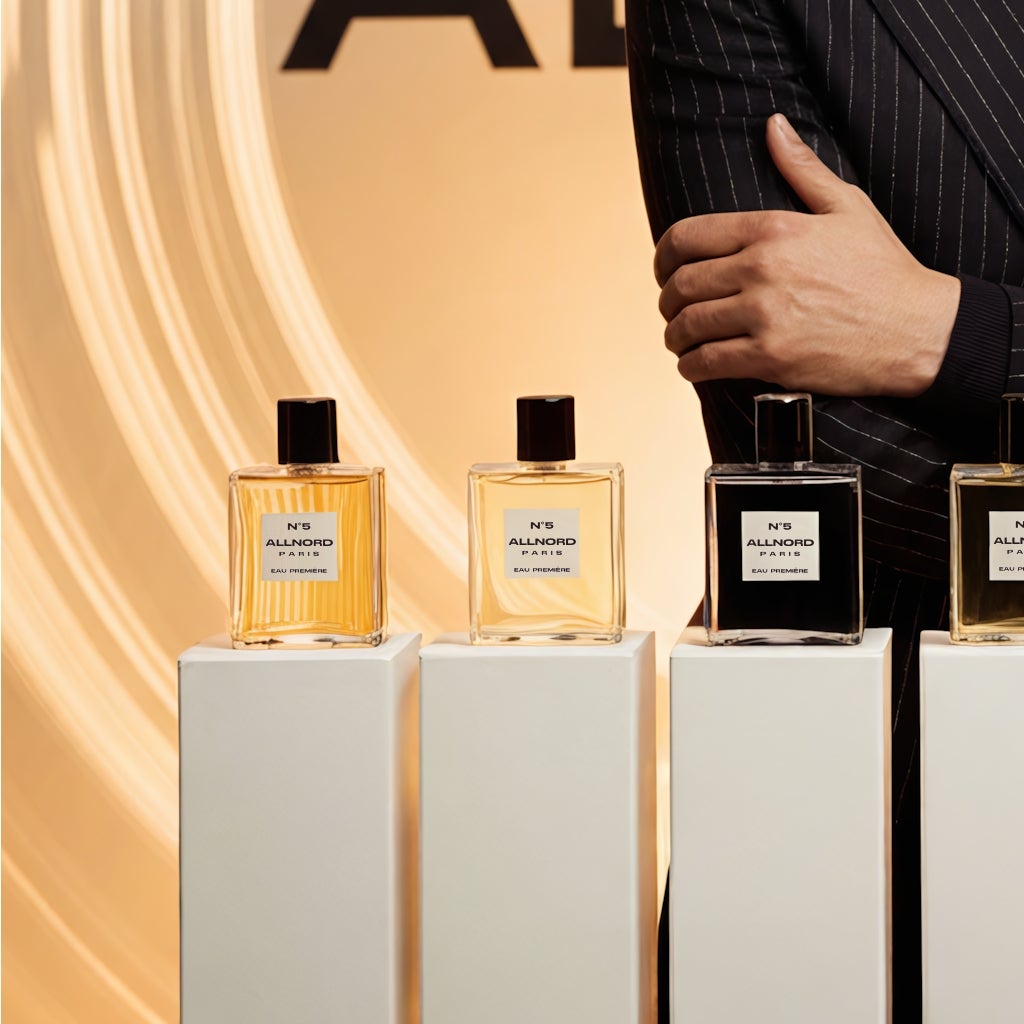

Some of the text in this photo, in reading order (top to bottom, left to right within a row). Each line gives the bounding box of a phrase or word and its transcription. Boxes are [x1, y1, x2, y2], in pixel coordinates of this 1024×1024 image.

[265, 538, 334, 546] ALLNORD
[508, 538, 577, 546] ALLNORD
[746, 538, 815, 546] ALLNORD
